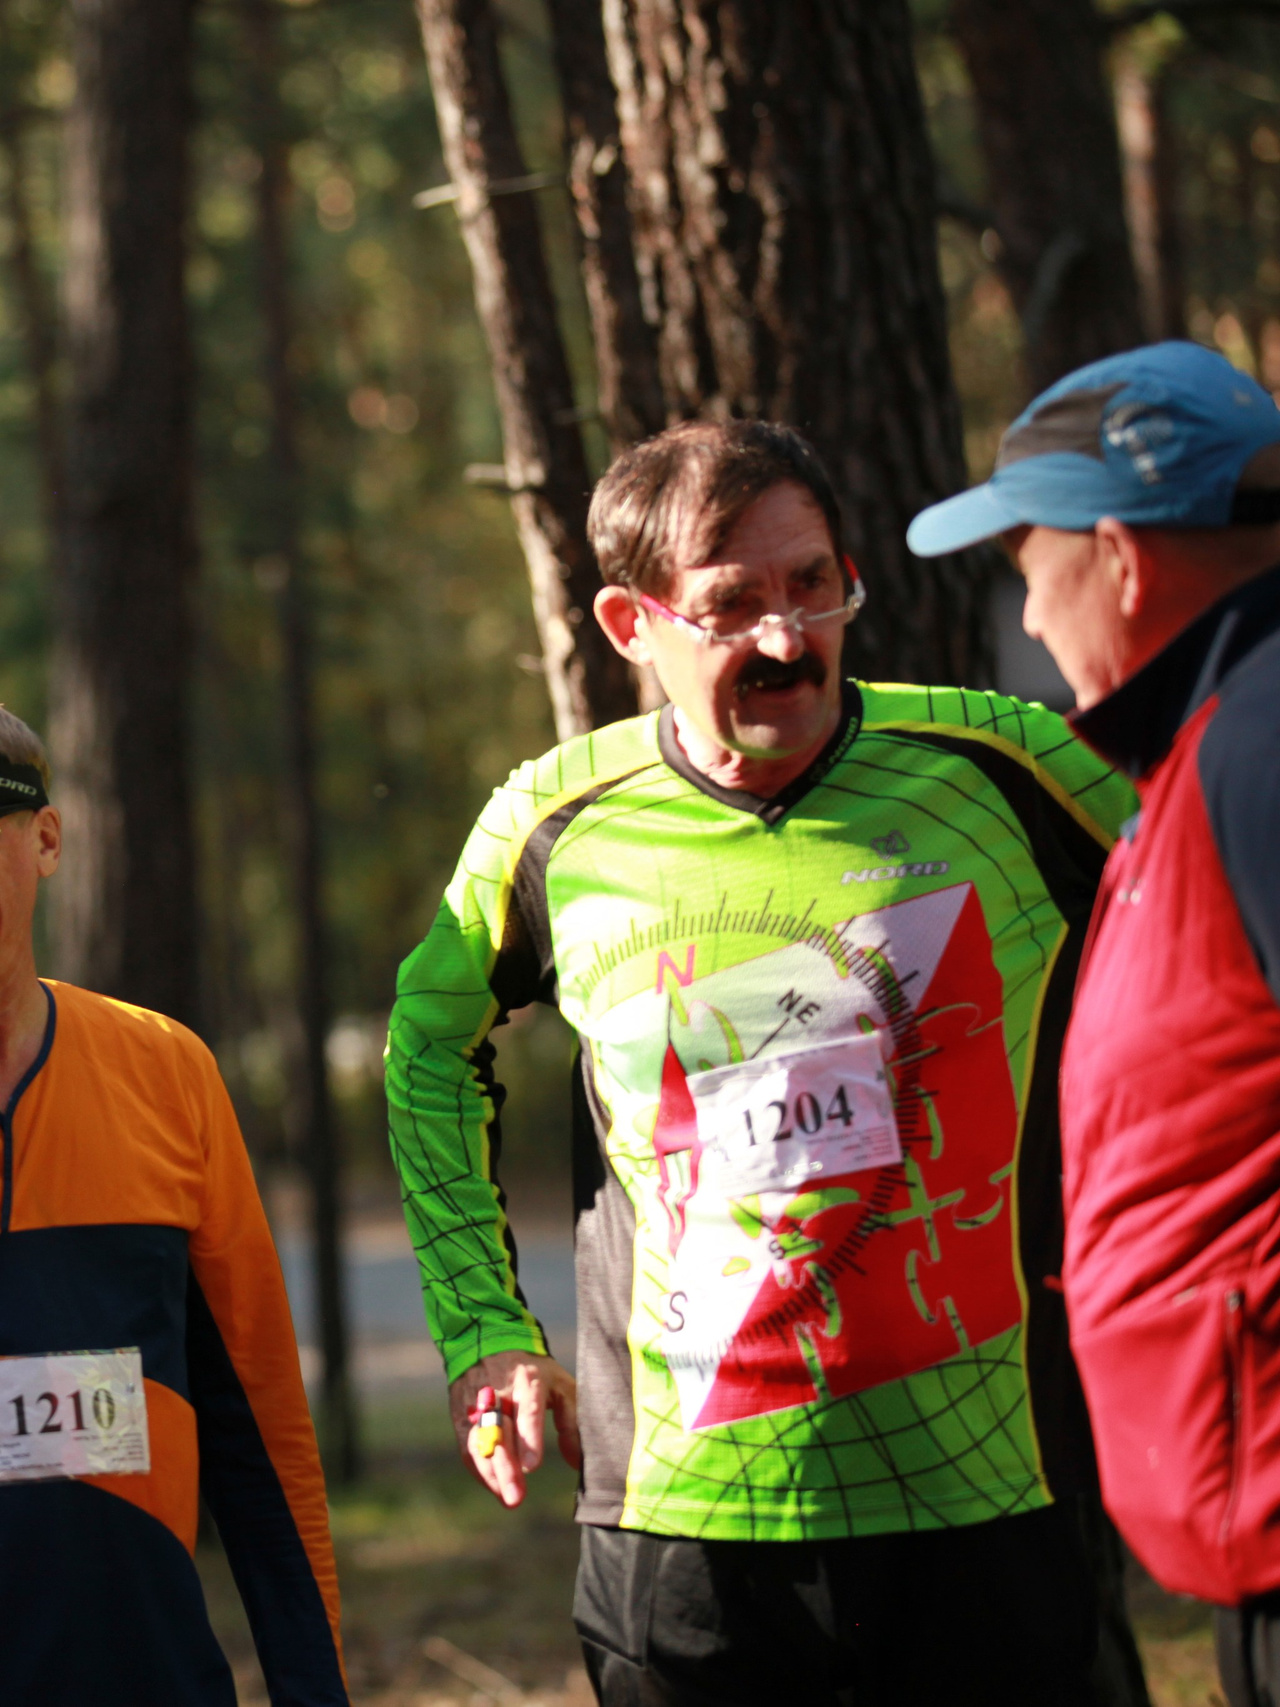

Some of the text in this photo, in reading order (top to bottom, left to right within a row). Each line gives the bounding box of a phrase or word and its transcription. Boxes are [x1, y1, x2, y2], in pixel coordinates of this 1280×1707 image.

[841, 861, 950, 885] NORD
[656, 943, 696, 995] N
[777, 987, 821, 1025] NE
[743, 1084, 854, 1146] 1204
[664, 1290, 688, 1333] S
[9, 1387, 116, 1437] 1210
